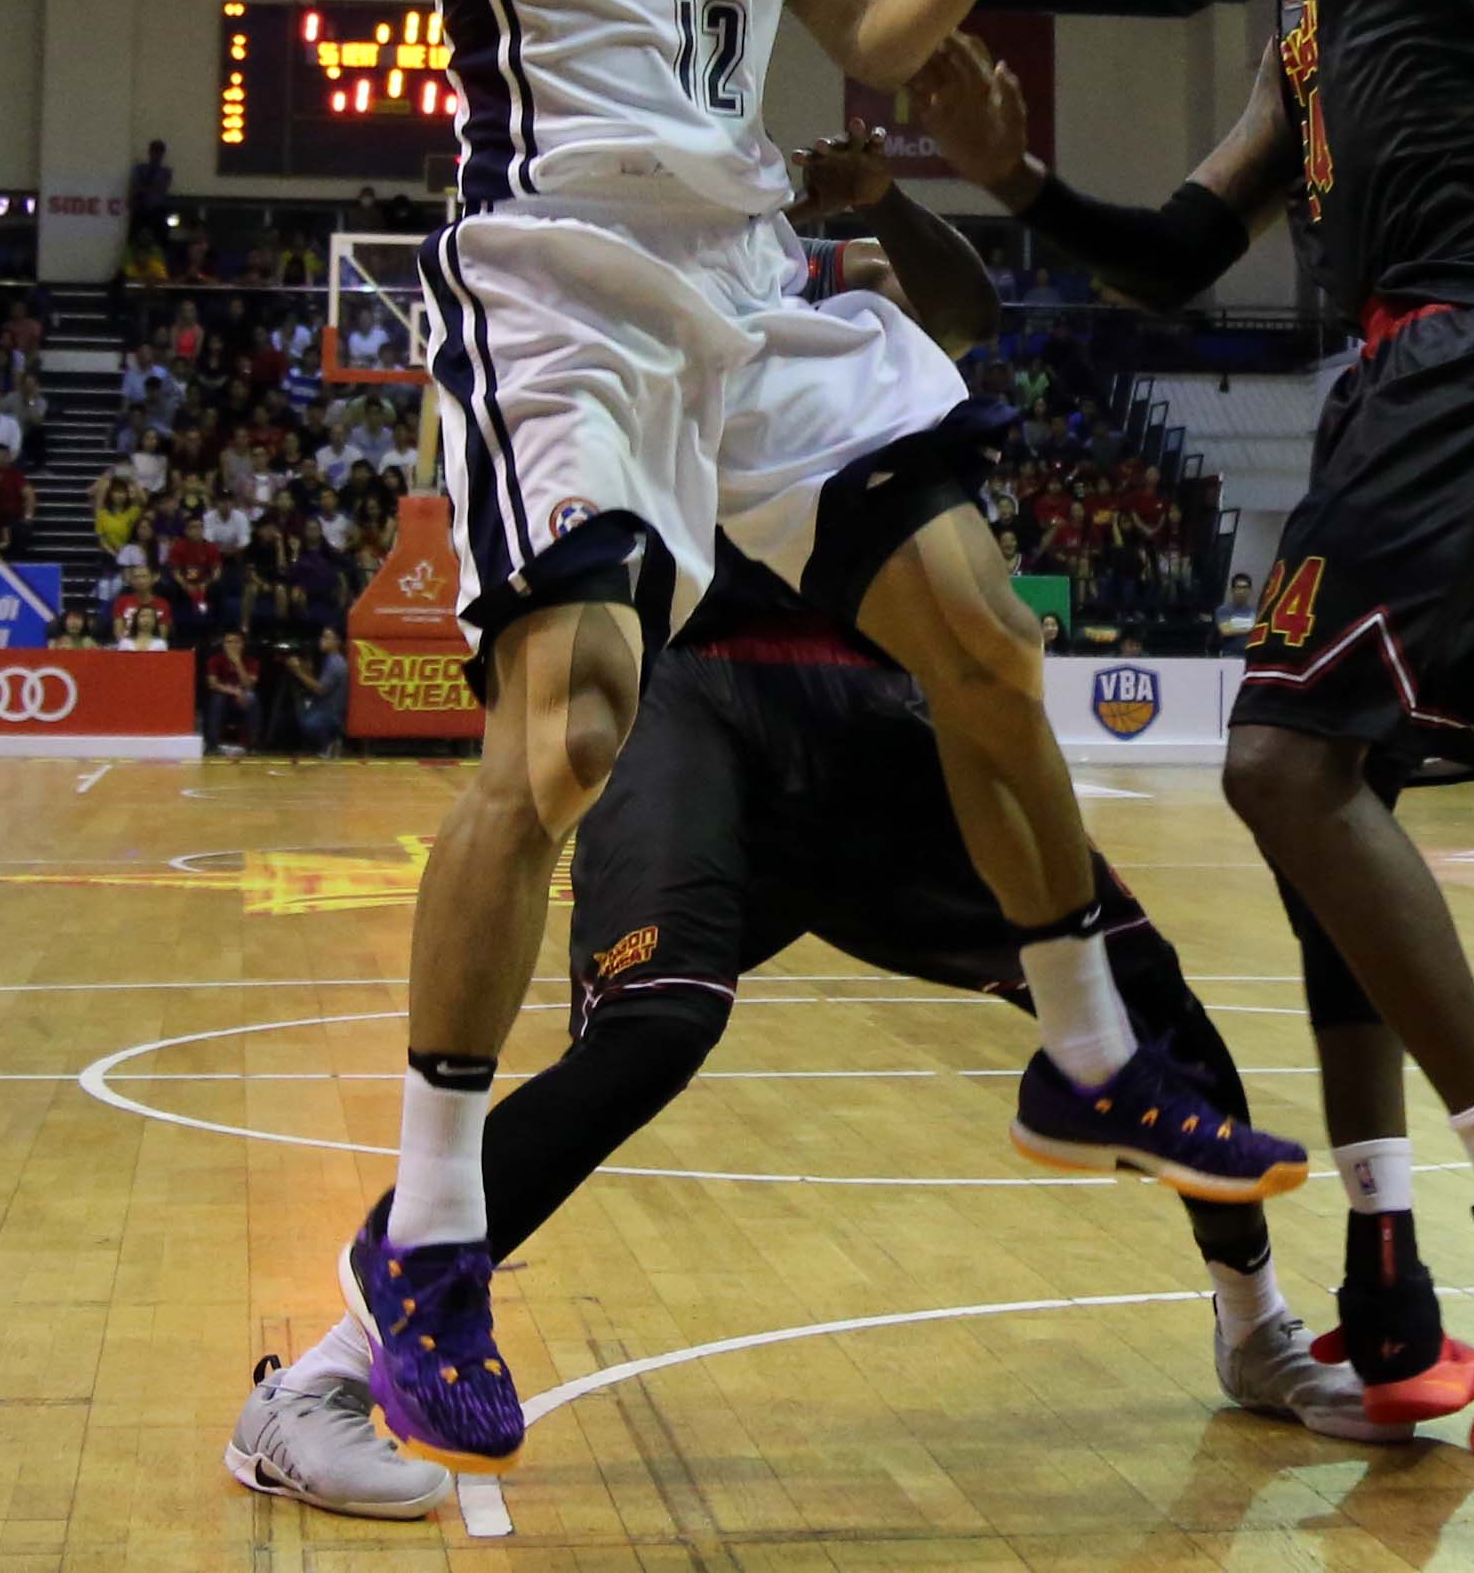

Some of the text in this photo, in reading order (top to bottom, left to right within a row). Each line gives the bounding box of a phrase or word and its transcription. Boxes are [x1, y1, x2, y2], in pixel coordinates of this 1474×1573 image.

[48, 195, 101, 216] SIDE
[361, 656, 467, 684] SAIGO
[1099, 671, 1154, 701] VBA
